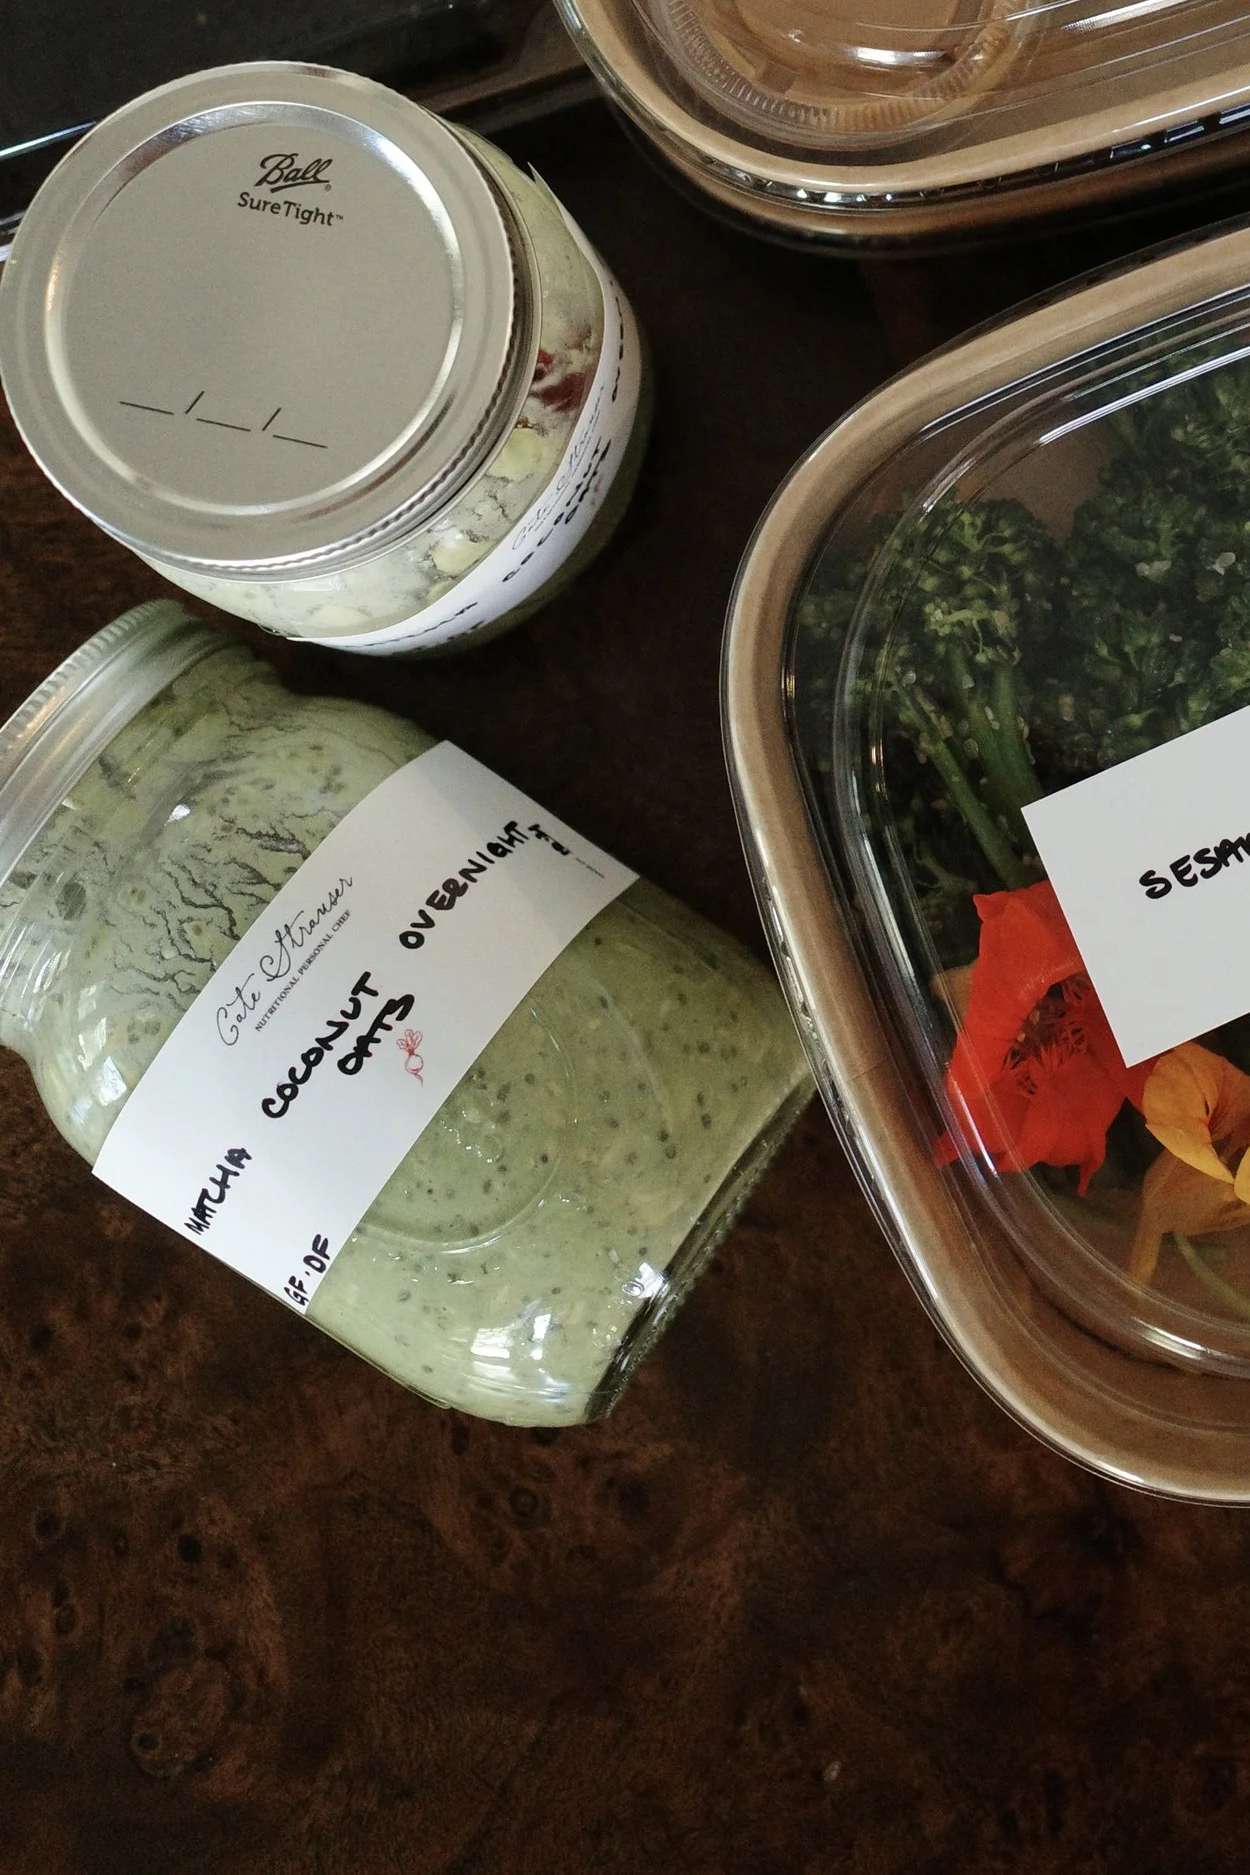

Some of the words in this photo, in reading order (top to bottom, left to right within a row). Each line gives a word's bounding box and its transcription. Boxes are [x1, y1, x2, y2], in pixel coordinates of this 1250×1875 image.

[255, 152, 333, 193] Ball
[254, 977, 301, 1033] NUTRITIONAL
[298, 931, 335, 978] PERSONAL
[331, 909, 352, 935] CHEF
[184, 1146, 252, 1234] MATCHA
[261, 971, 379, 1118] COCONUT
[399, 820, 531, 949] OVERNIGHT
[337, 993, 415, 1075] OATS
